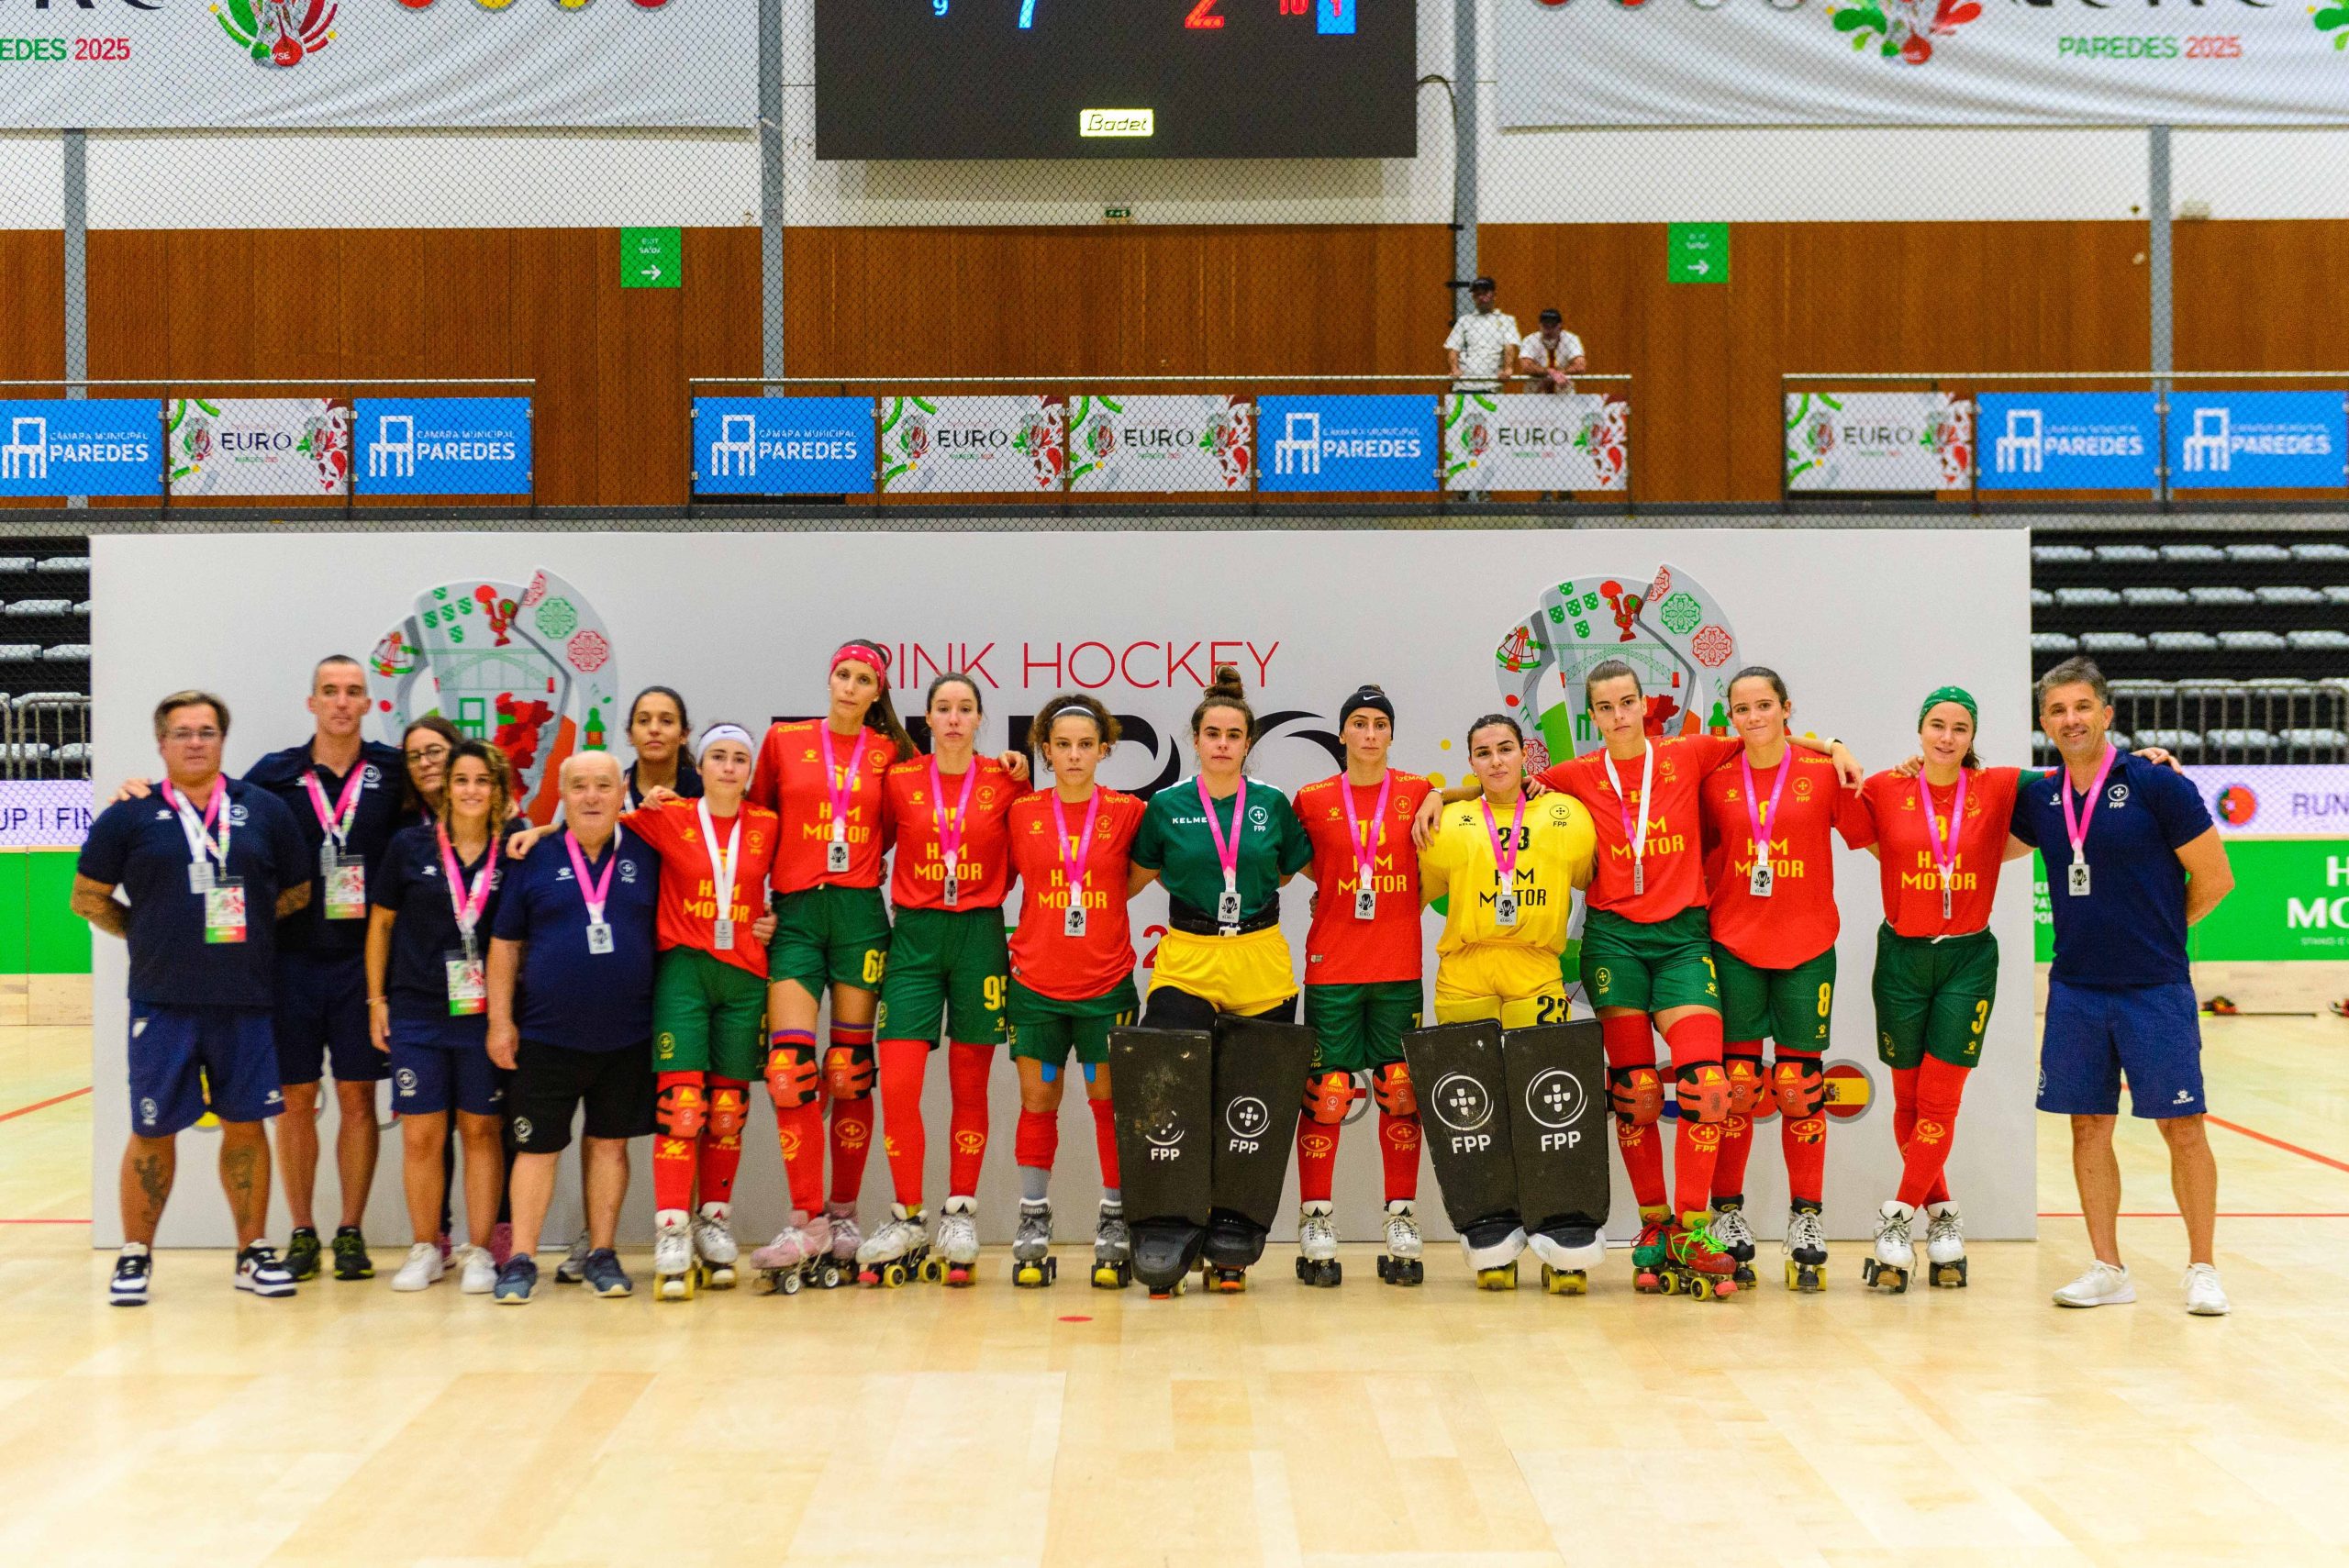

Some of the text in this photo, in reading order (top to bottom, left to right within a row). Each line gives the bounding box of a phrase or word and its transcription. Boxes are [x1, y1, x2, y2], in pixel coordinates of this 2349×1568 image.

[0, 38, 131, 61] EDES 2025
[2058, 35, 2243, 60] PAREDES 2025
[221, 431, 292, 451] EURO
[938, 428, 1008, 448] EURO
[1124, 428, 1194, 447] EURO
[1498, 427, 1568, 447] EURO
[1843, 426, 1913, 446] EURO
[2043, 435, 2144, 456] PAREDES
[2230, 434, 2332, 455] PAREDES
[50, 443, 150, 462] PAREDES
[417, 442, 516, 461] PAREDES
[759, 440, 857, 460] PAREDES
[1322, 439, 1421, 458] PAREDES
[1022, 641, 1280, 689] HOCKEY
[889, 764, 924, 775] AZEMAD
[1299, 781, 1335, 795] AZEMAD
[2292, 794, 2349, 816] RUN
[1398, 814, 1411, 822] FPP
[802, 822, 871, 844] MOOR
[1497, 826, 1531, 851] 23
[1610, 833, 1686, 862] MTOR
[914, 862, 983, 881] MOOR
[1734, 859, 1805, 878] MTOR
[1338, 873, 1408, 896] MTOR
[1038, 891, 1108, 909] MOOR
[1479, 888, 1547, 908] MTOR
[683, 897, 751, 923] MOOR
[1536, 995, 1569, 1025] 23
[1817, 982, 1831, 1018] 8
[1971, 1000, 1988, 1034] 3
[1229, 1139, 1260, 1154] FPP
[1451, 1134, 1492, 1154] FPP
[1541, 1130, 1582, 1151] FPP
[1695, 1144, 1717, 1152] FPP
[1151, 1148, 1181, 1161] FPP
